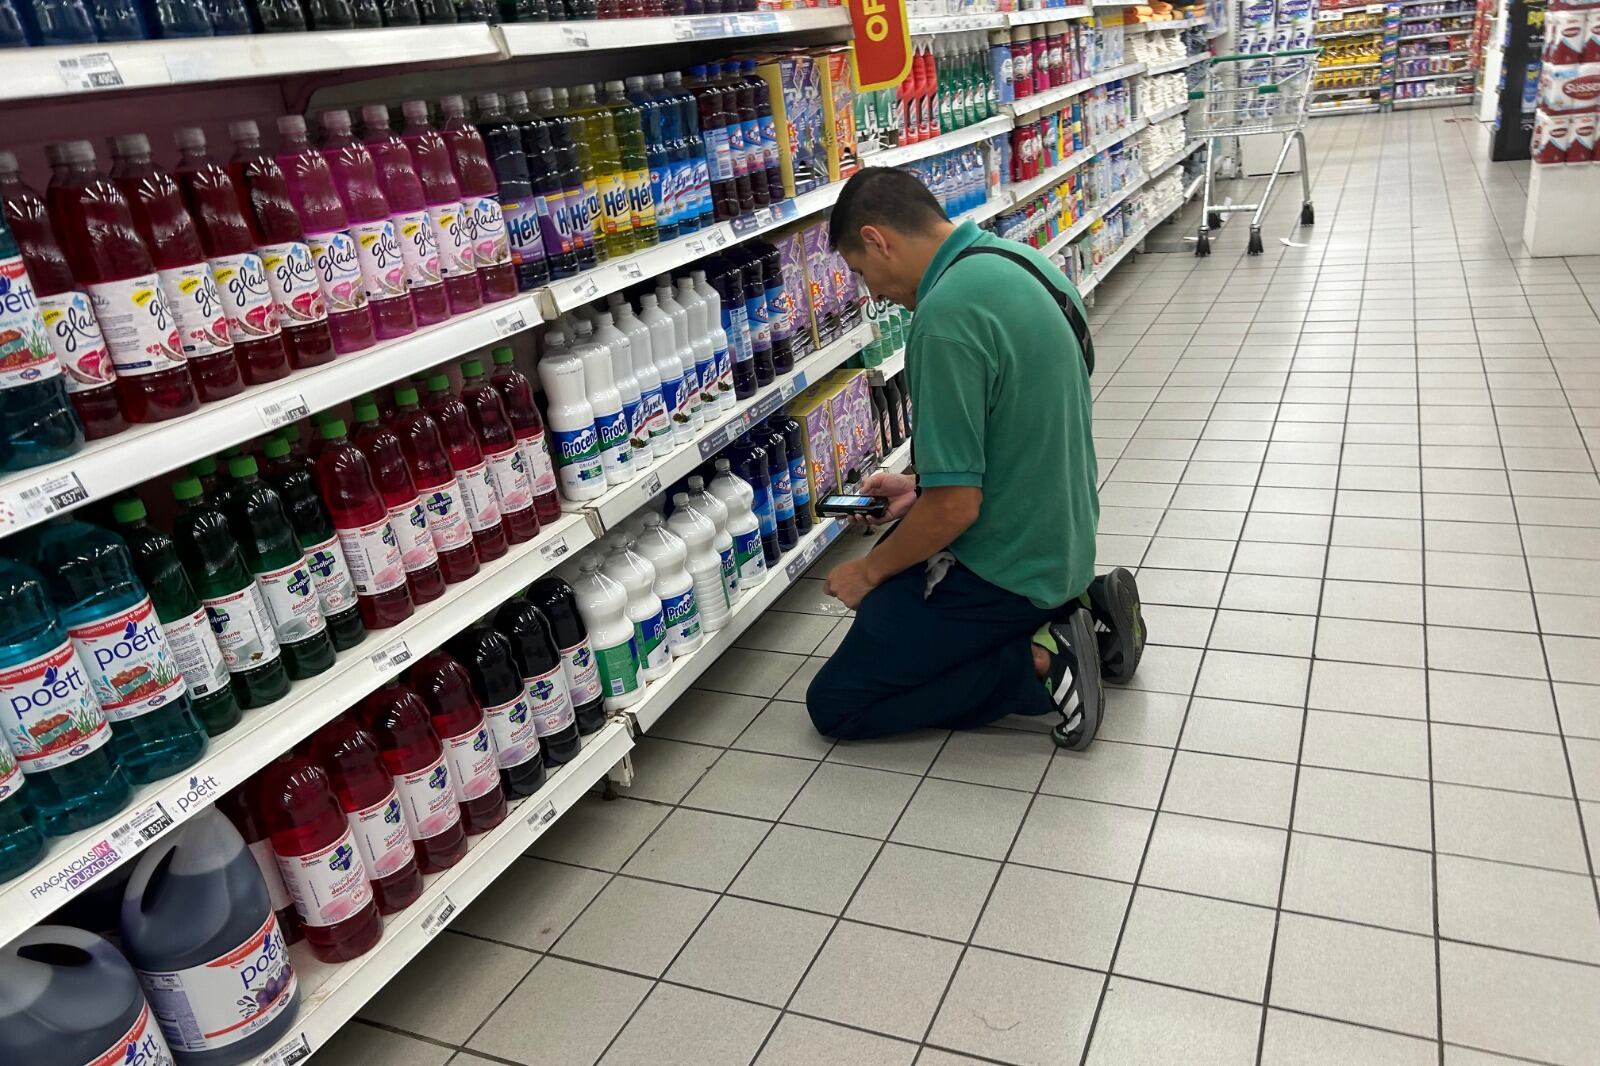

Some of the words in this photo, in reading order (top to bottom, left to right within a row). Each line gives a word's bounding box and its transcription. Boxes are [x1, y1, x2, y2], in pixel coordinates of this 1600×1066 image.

[604, 188, 627, 217] Hér
[629, 182, 652, 212] Hér
[229, 267, 267, 307] glad
[56, 307, 100, 352] glad
[602, 417, 627, 443] Proce
[287, 575, 310, 593] Lysofor
[94, 622, 161, 672] poett
[10, 666, 84, 720] poett
[177, 775, 219, 812] poett
[30, 851, 96, 899] FRAGANCIAS
[60, 882, 70, 893] Y
[69, 852, 119, 889] DURADER
[132, 1033, 160, 1066] ett
